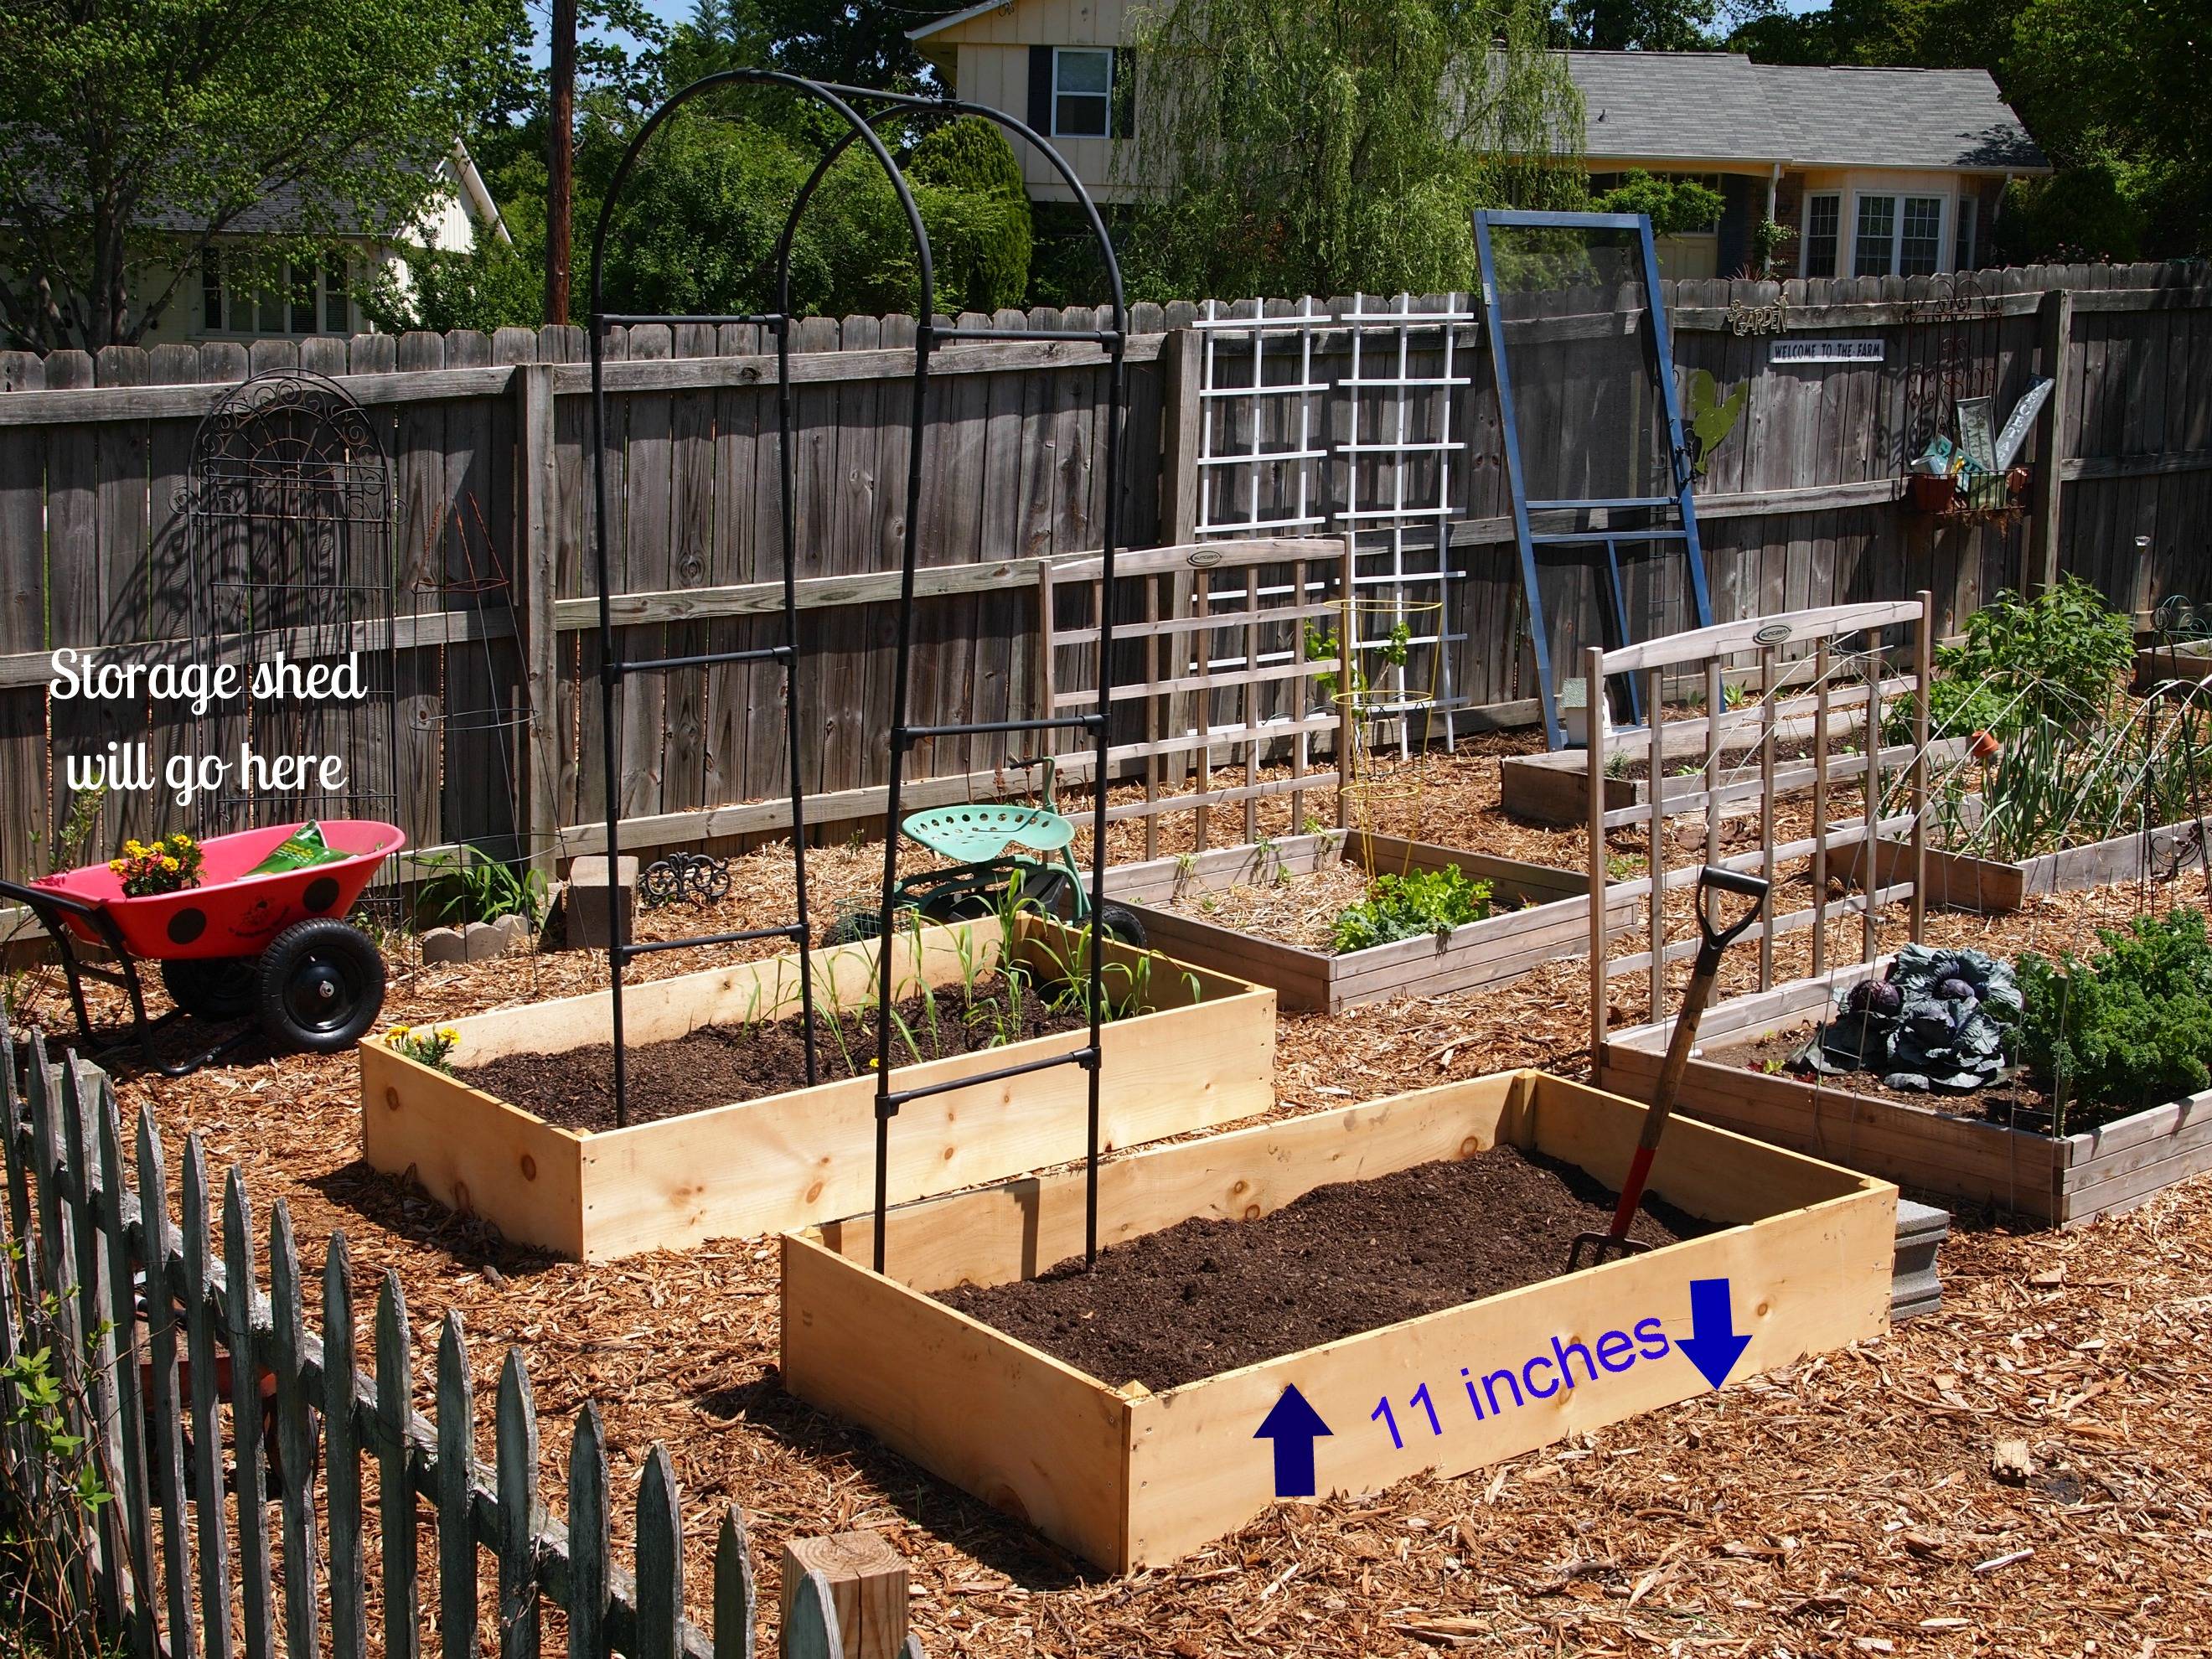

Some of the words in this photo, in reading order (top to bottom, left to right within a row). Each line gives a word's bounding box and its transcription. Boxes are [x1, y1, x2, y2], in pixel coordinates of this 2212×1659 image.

[1732, 307, 1789, 336] GARDEN
[1775, 344, 1817, 359] WELCOME
[1822, 343, 1832, 358] TO
[1837, 343, 1853, 358] THE
[1857, 343, 1880, 358] FARM
